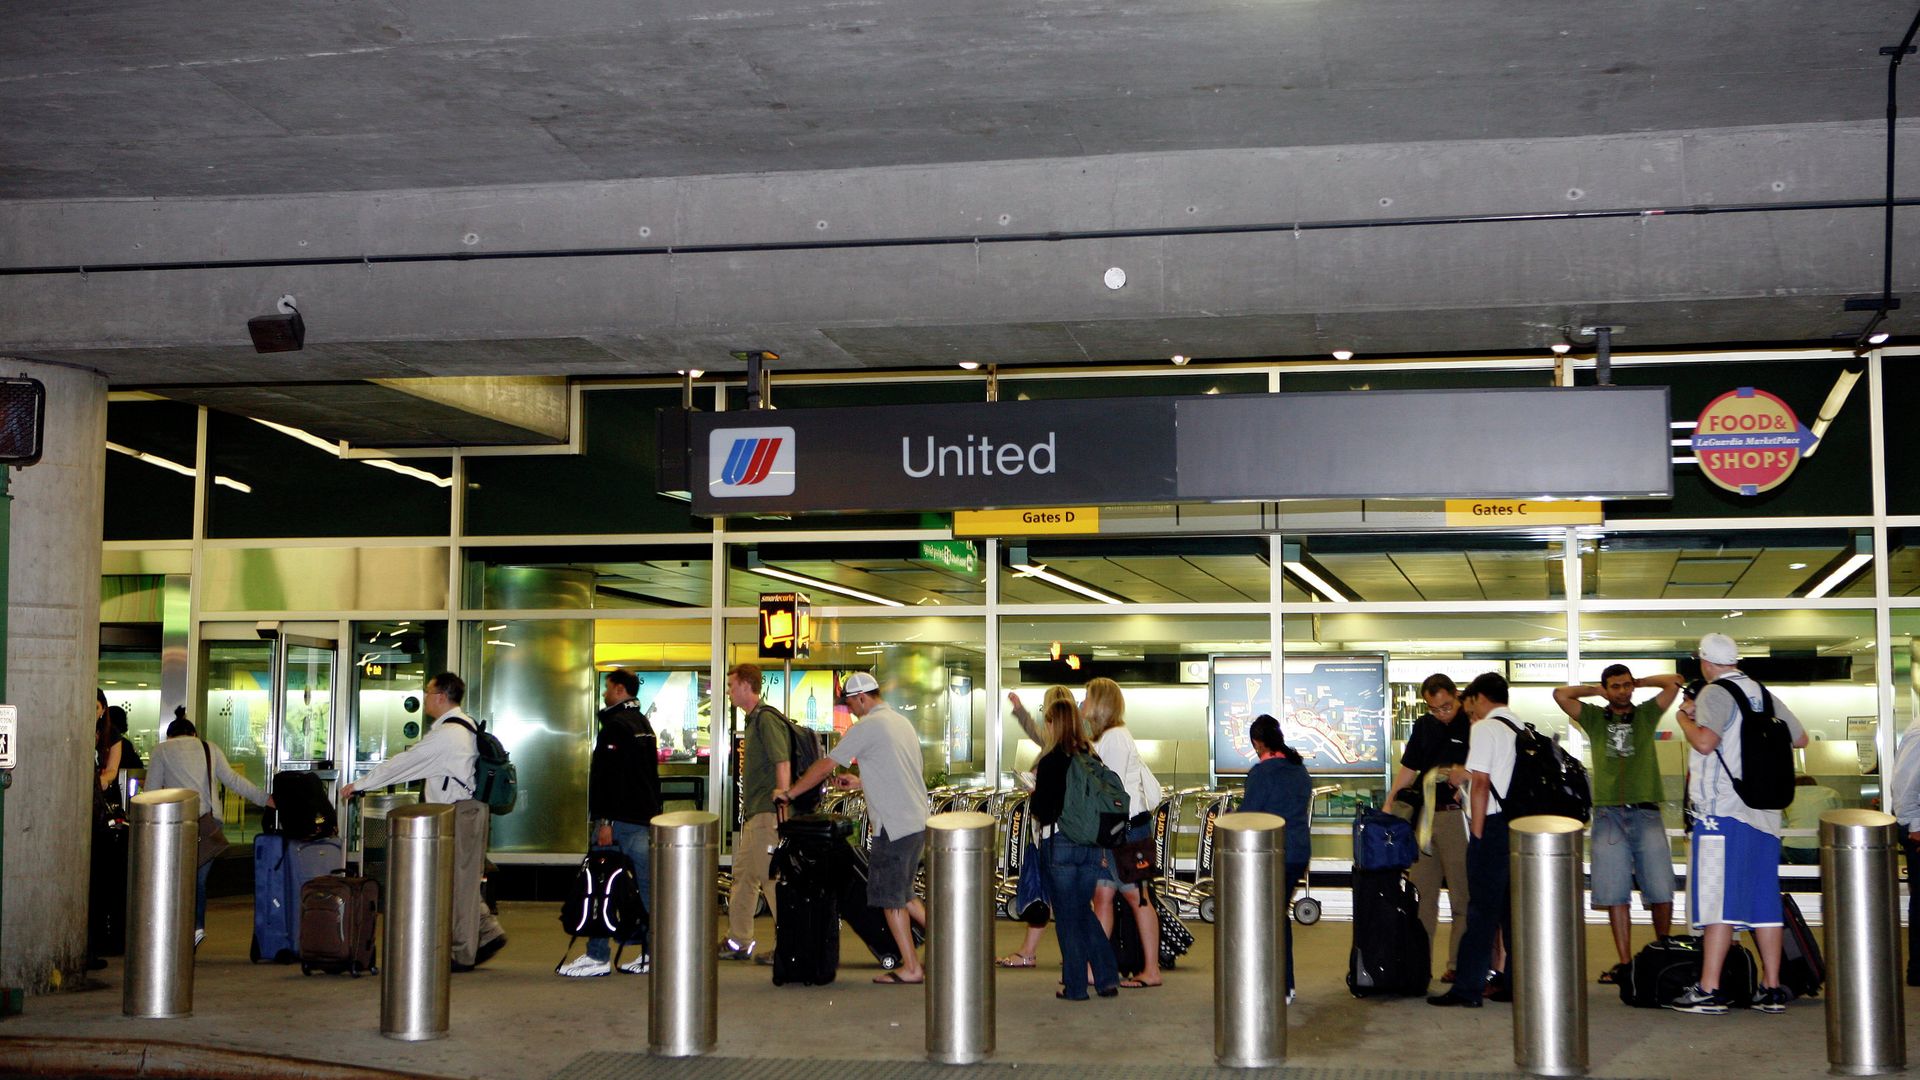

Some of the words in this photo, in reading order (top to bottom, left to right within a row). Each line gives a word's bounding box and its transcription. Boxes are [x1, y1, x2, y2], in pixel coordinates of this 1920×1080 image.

[1697, 438, 1743, 446] LaGuardia
[1746, 436, 1799, 445] MarketPlace
[902, 431, 1057, 478] United
[1710, 451, 1789, 470] SHOPS
[1022, 511, 1061, 524] Gates
[1064, 511, 1075, 523] D
[1472, 503, 1513, 516] Gates
[1517, 503, 1527, 515] C
[1010, 811, 1021, 869] smartecarte
